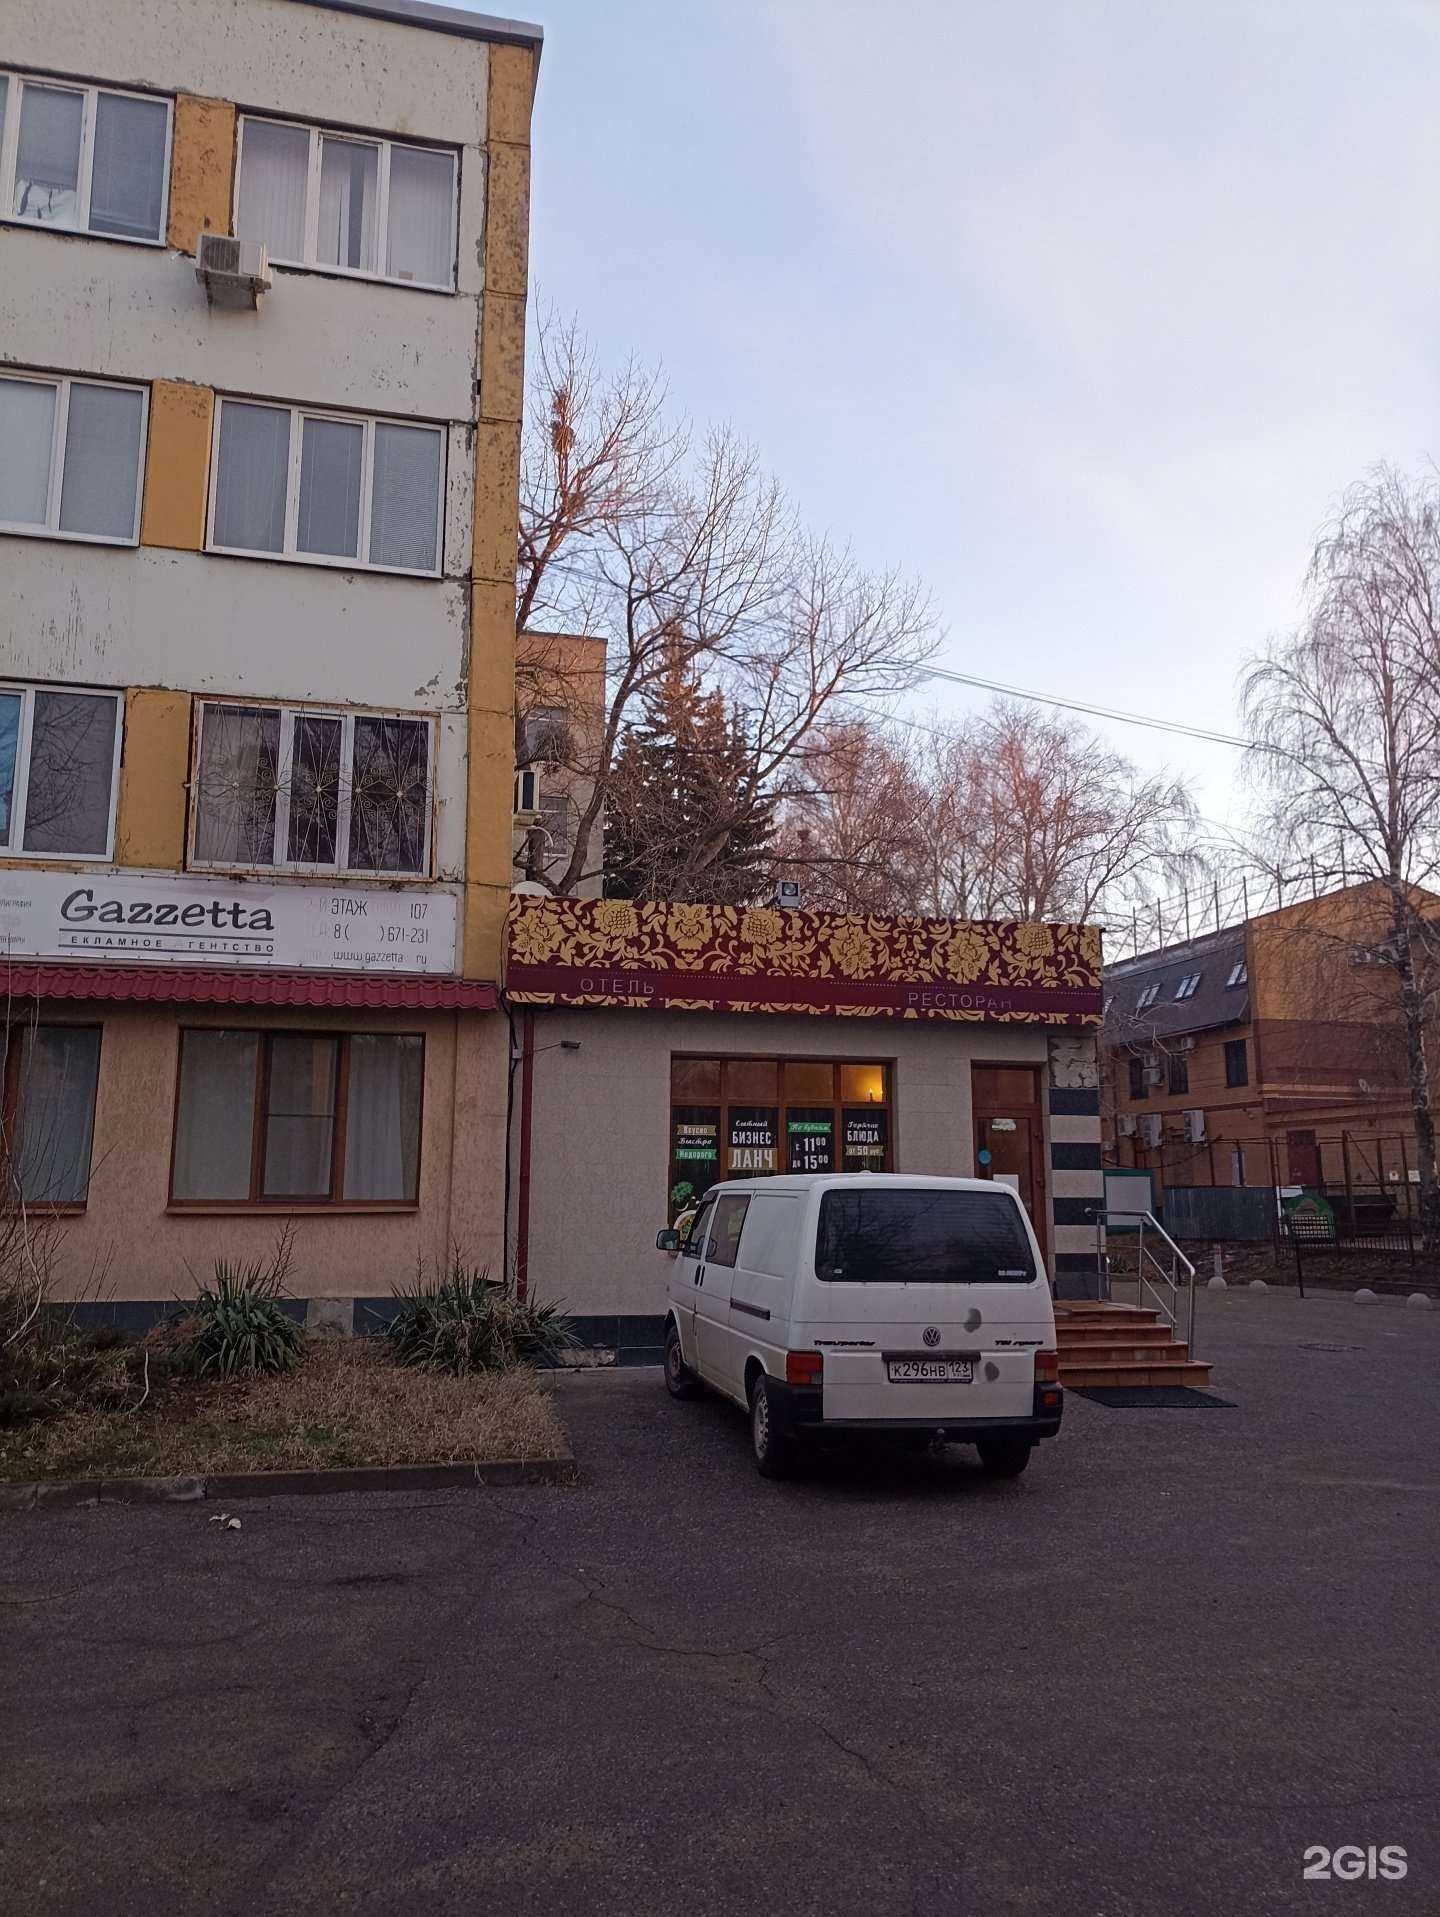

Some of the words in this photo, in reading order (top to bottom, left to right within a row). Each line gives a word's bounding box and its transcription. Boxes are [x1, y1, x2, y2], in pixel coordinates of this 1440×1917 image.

[60, 888, 275, 931] Gazzetta
[331, 898, 368, 916] ЭТАЖ
[410, 903, 428, 920] 107
[580, 978, 655, 994] ОТЕЛЬ
[908, 992, 1012, 1009] РЕСТОРАН
[683, 1126, 708, 1135] Вкусно
[732, 1131, 772, 1145] БИЗНЕС
[847, 1130, 879, 1143] БЛЮДА
[731, 1149, 773, 1168] ЛАНЧ
